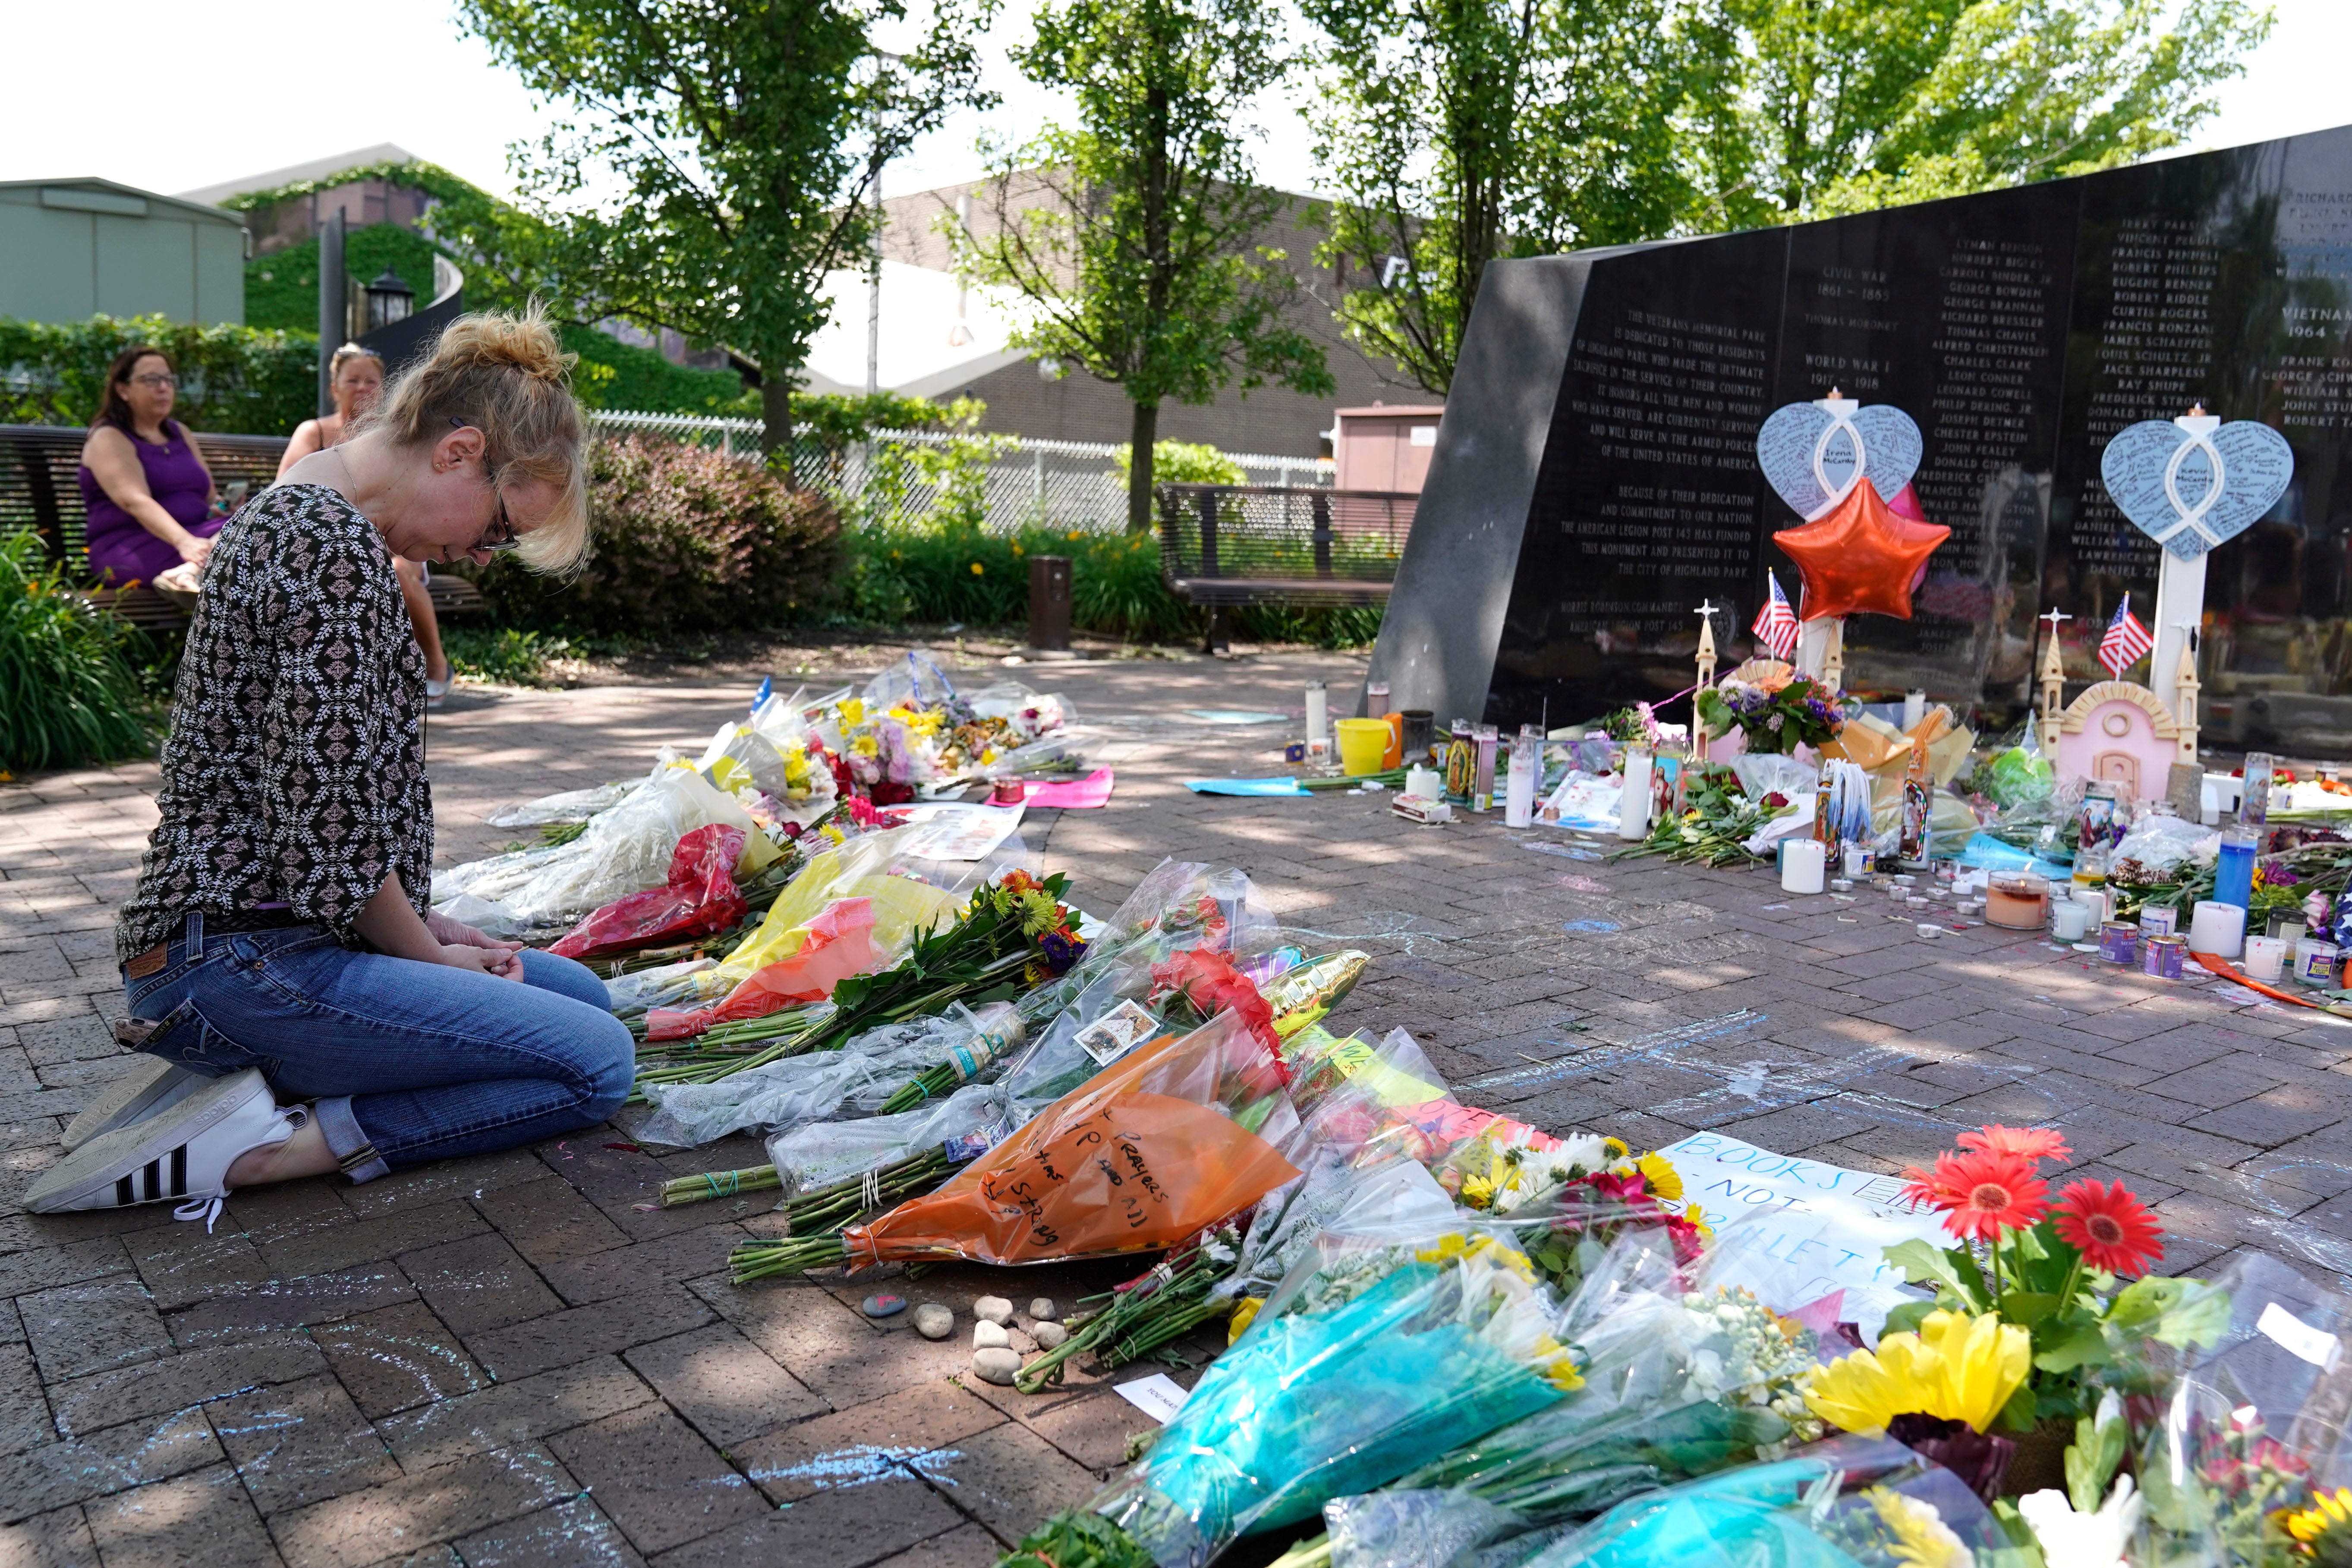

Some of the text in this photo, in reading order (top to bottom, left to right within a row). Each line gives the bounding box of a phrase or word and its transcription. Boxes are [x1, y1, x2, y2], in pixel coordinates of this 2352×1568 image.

[1823, 266, 1886, 283] CIVIL WAR
[2113, 262, 2159, 274] ROBERT
[1818, 283, 1841, 297] 1861
[1949, 281, 2042, 298] GEORGE BOWDEN
[2113, 277, 2159, 289] EUGENE
[1943, 296, 2045, 313] GEORGE BRANNAN
[2115, 291, 2209, 305] ROBERT RIDDLE
[1941, 311, 2044, 327] RICHARD BRESSLER
[2113, 305, 2207, 320] CURTIS ROGERS
[1628, 309, 1766, 343] THE VETERANS MEMORIAL PARK
[1947, 325, 1991, 338] THOMAS
[2103, 320, 2153, 332] FRANCIS
[2289, 325, 2327, 339] 1964
[1615, 326, 1765, 361] IS DEDICATED TO THOSE RESIDENTS
[1931, 340, 2049, 357] ALFRED CHRISTENSEN
[1588, 340, 1624, 359] HIGHLAND
[1627, 349, 1647, 363] PARK
[1651, 353, 1670, 366] WHO
[1673, 357, 1696, 371] MADE
[1700, 361, 1716, 374] THE
[1720, 363, 1764, 379] ULTIMATE
[1805, 353, 1878, 373] WORLD WAR
[1944, 355, 2031, 371] CHARLES CLARK
[2281, 356, 2325, 367] FRANK
[1573, 359, 1607, 376] SACRIFICE
[1622, 368, 1637, 381] THE
[1640, 371, 1672, 387] SERVICE
[1676, 376, 1687, 388] OF
[1691, 379, 1715, 393] THEIR
[1948, 370, 2023, 385] LEON CONNER
[2102, 363, 2206, 378] JACK SHARPLESS
[2262, 370, 2313, 381] GEORGE
[1936, 384, 1986, 397] LEONARD
[2118, 379, 2143, 390] RAY
[2283, 386, 2339, 397] WILLIAM
[1609, 386, 1640, 401] HONORS
[1644, 392, 1659, 405] ALL
[1663, 394, 1679, 407] THE
[1683, 397, 1701, 409] MEN
[1705, 400, 1724, 412] AND
[1728, 402, 1761, 416] WOMEN
[1932, 399, 1966, 409] PHILIP
[2093, 393, 2155, 405] FREDERICK
[2281, 400, 2317, 412] JOHN
[1572, 400, 1717, 430] WHO HAVE ARE CURRENTLY
[2088, 406, 2135, 419] DONALD
[1939, 413, 2025, 428] JOSEPH DETMER
[2283, 414, 2336, 427] ROBERT
[1590, 423, 1722, 449] AND WILL SERVE IN THE ARMED
[1934, 427, 2028, 443] CHESTER EPSTEIN
[1942, 442, 1971, 453] JOHN
[1602, 444, 1713, 467] OF THE UNITED STATES OF
[1934, 456, 1978, 469] DONALD
[1618, 485, 1754, 507] BECAUSE OF THEIR DEDICATION
[1601, 504, 1713, 523] AND COMMITMENT TO OUR
[1561, 521, 1751, 543] THE AMERICAN LEGION POST 145 HAS FUNDED
[2074, 521, 2116, 533] DANIEL
[2072, 534, 2120, 547] WILLIAM
[1581, 542, 1750, 561] THIS MONUMENT AND PRESENTED IT TO
[2078, 549, 2140, 562] LAWRENCE
[1618, 563, 1720, 578] THE CITY OF HIGHLAND
[2090, 564, 2137, 577] DANIEL
[1644, 620, 1665, 632] POST
[1674, 1137, 1855, 1190] BOOKS
[1704, 1179, 1807, 1214] NOT
